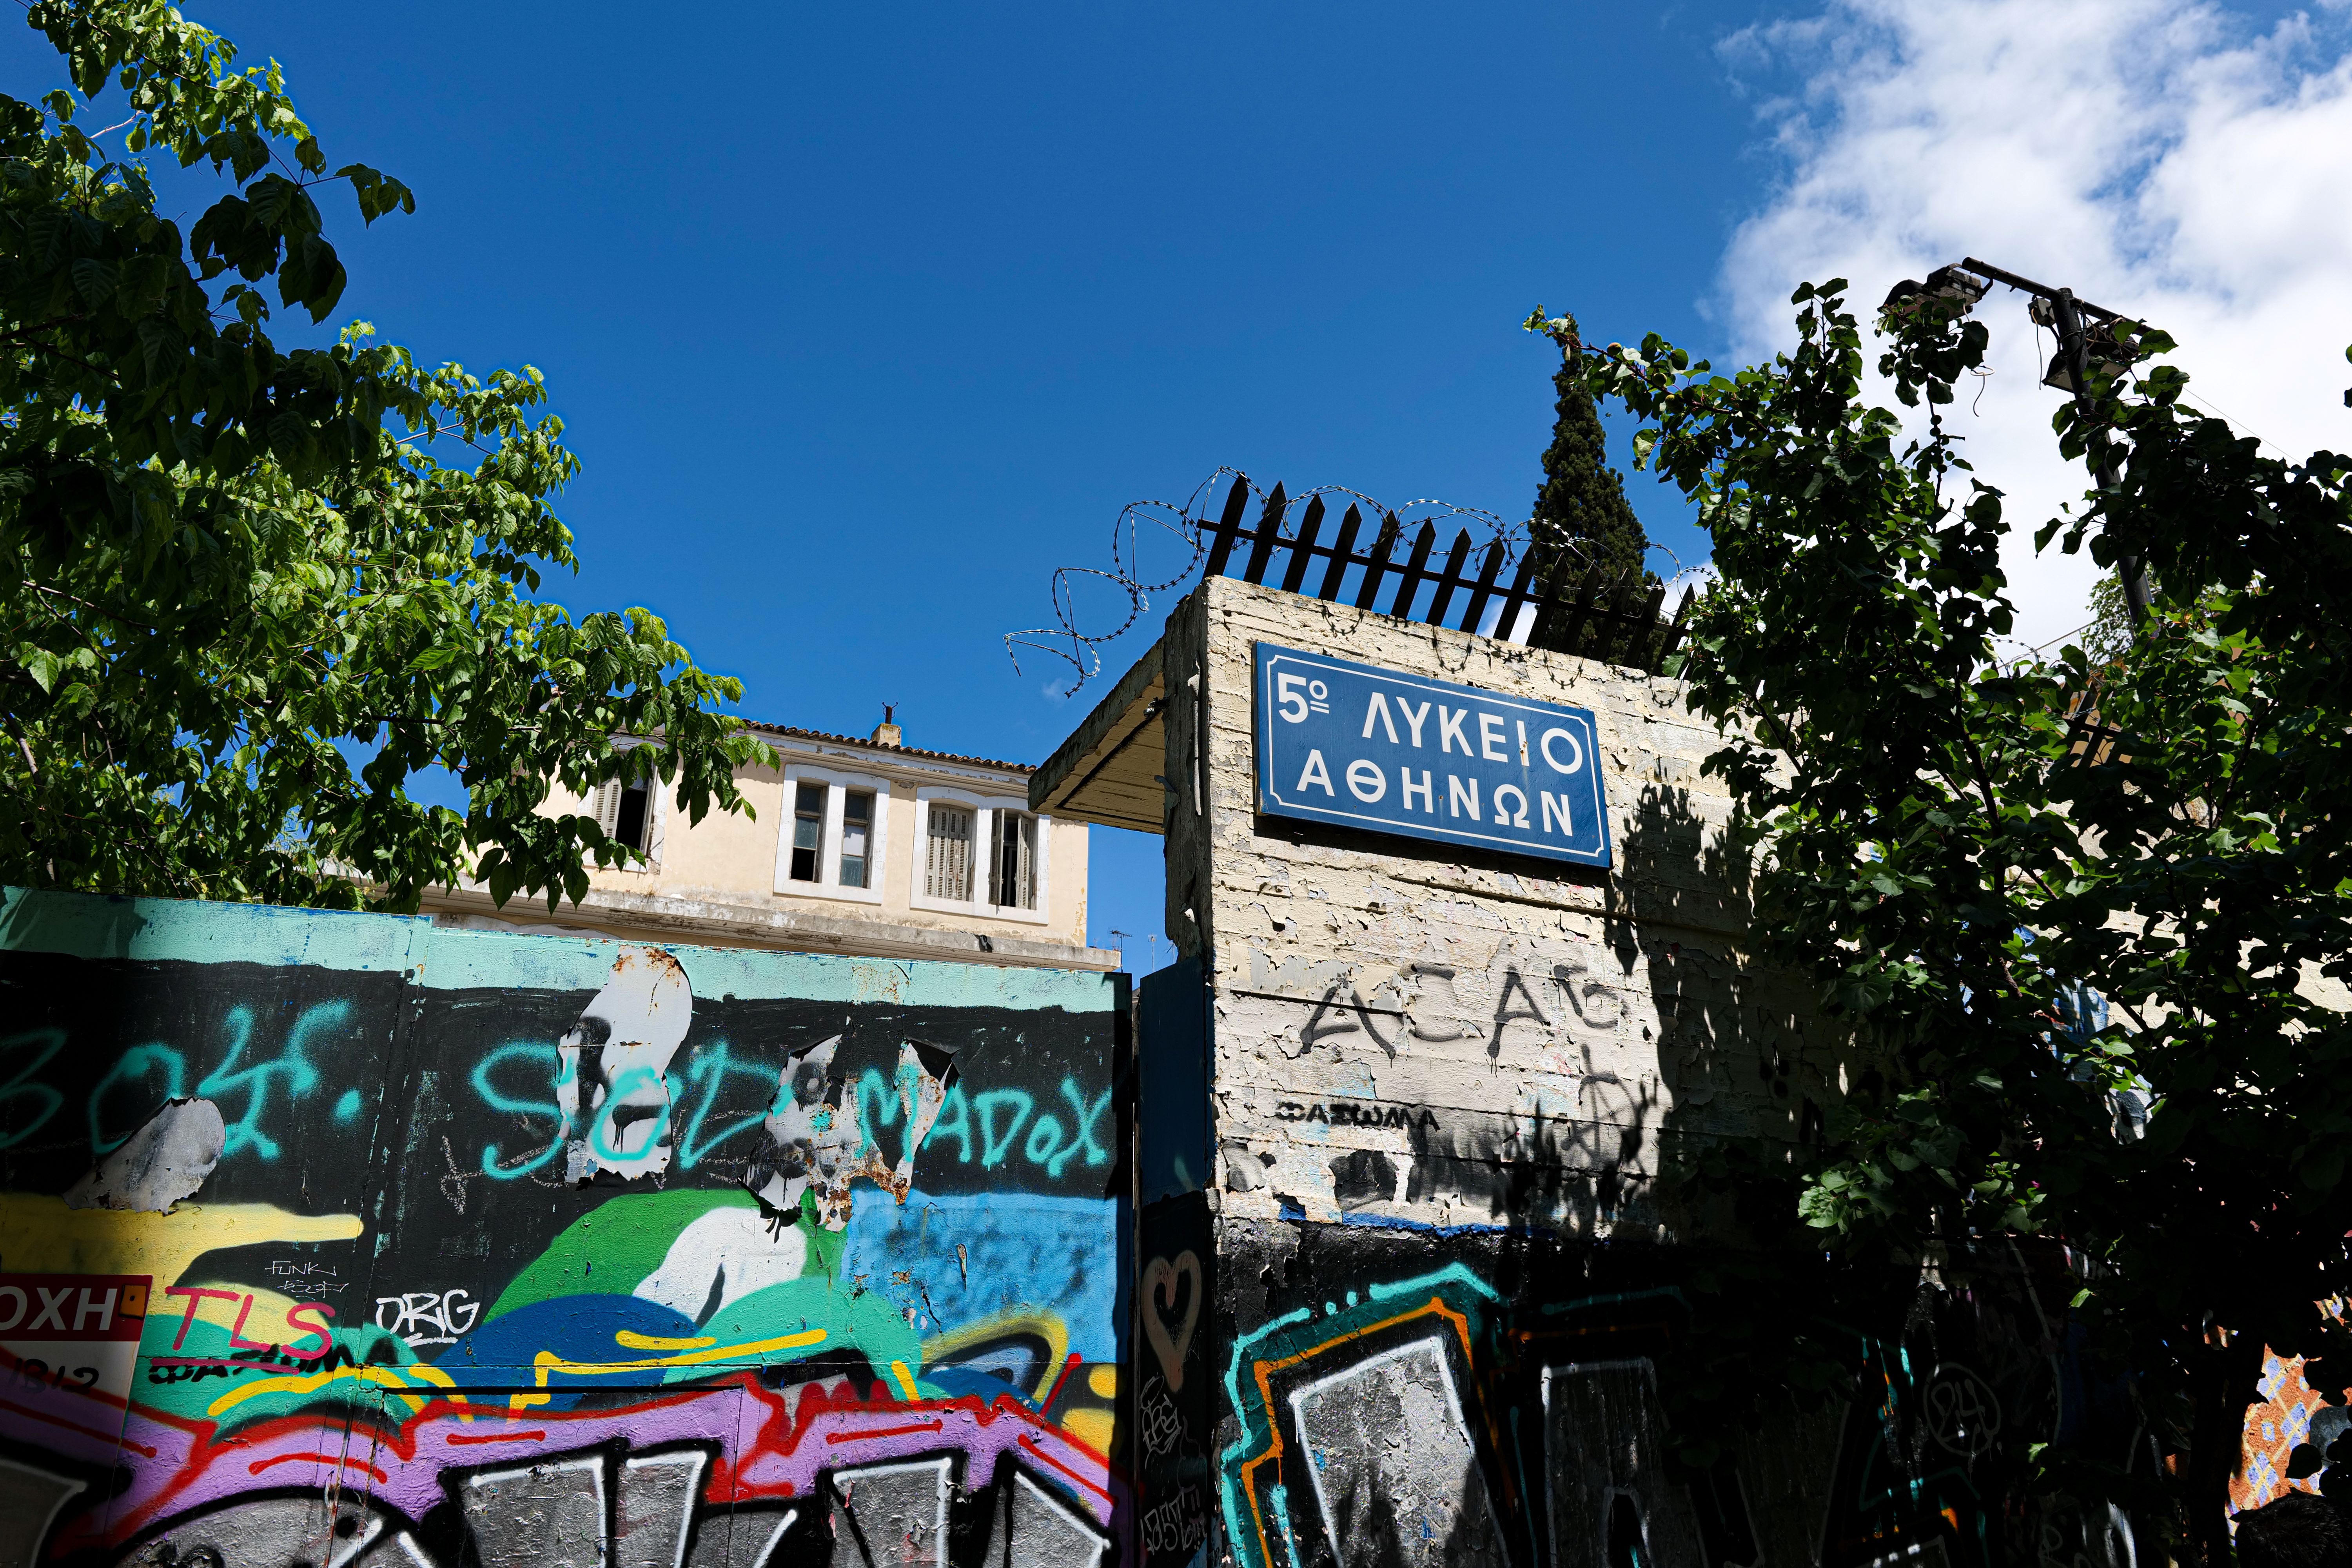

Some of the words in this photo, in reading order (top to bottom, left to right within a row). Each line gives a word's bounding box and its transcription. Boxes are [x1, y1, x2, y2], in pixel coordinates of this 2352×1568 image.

[1362, 692, 1583, 774] ΛΥΚΕΙΟ
[1296, 749, 1573, 837] ΑΘΗΝΩΝ
[165, 1285, 336, 1359] TLS
